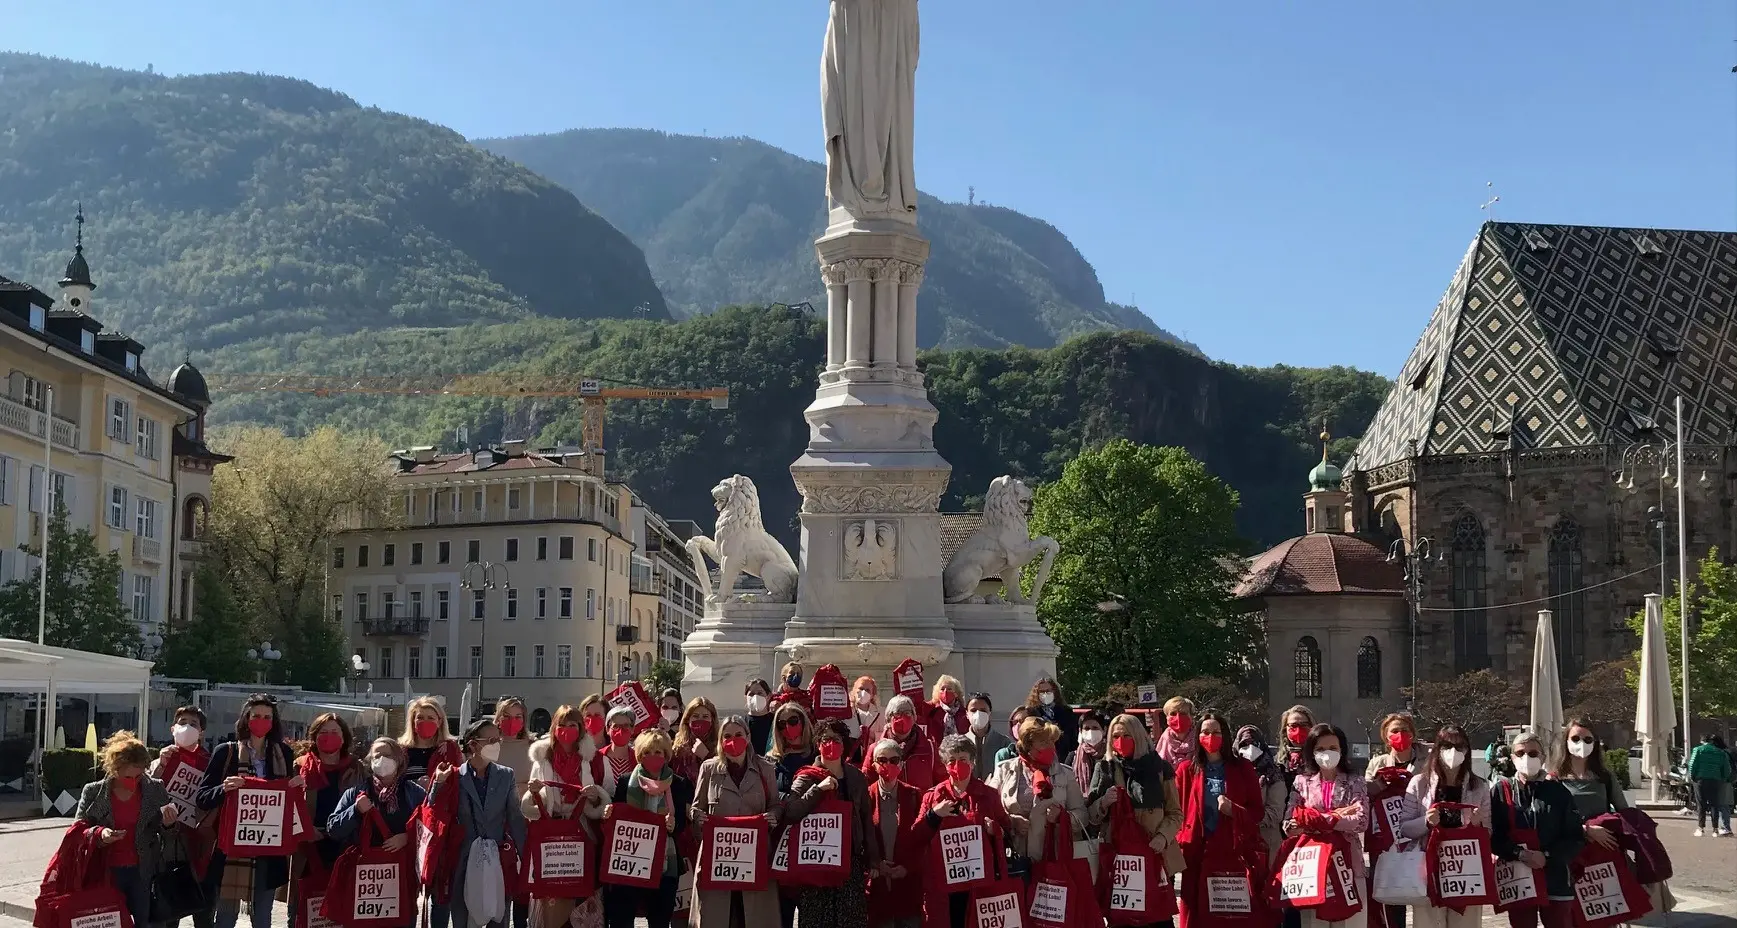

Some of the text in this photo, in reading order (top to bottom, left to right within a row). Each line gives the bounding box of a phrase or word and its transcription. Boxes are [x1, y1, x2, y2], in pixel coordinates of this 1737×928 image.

[625, 690, 647, 719] equal
[177, 766, 200, 786] equ
[168, 780, 195, 800] pay
[241, 792, 281, 807] equal
[239, 808, 267, 823] pay
[802, 815, 839, 829] equal
[617, 824, 656, 840] equal
[716, 830, 754, 845] equal
[802, 830, 827, 844] pay
[943, 827, 979, 846] equal
[614, 838, 640, 855] pay
[715, 846, 740, 860] pay
[945, 845, 969, 862] pay
[1439, 841, 1477, 860] equal
[1290, 848, 1317, 864] qual
[1115, 858, 1142, 873] qual
[1284, 864, 1304, 878] pay
[1440, 860, 1463, 875] pay
[358, 865, 396, 882] equal
[1114, 873, 1129, 888] ay
[1496, 866, 1514, 881] pay
[358, 883, 384, 897] pay
[1579, 883, 1604, 900] pay
[979, 895, 1016, 915] equal
[981, 915, 1006, 928] pay
